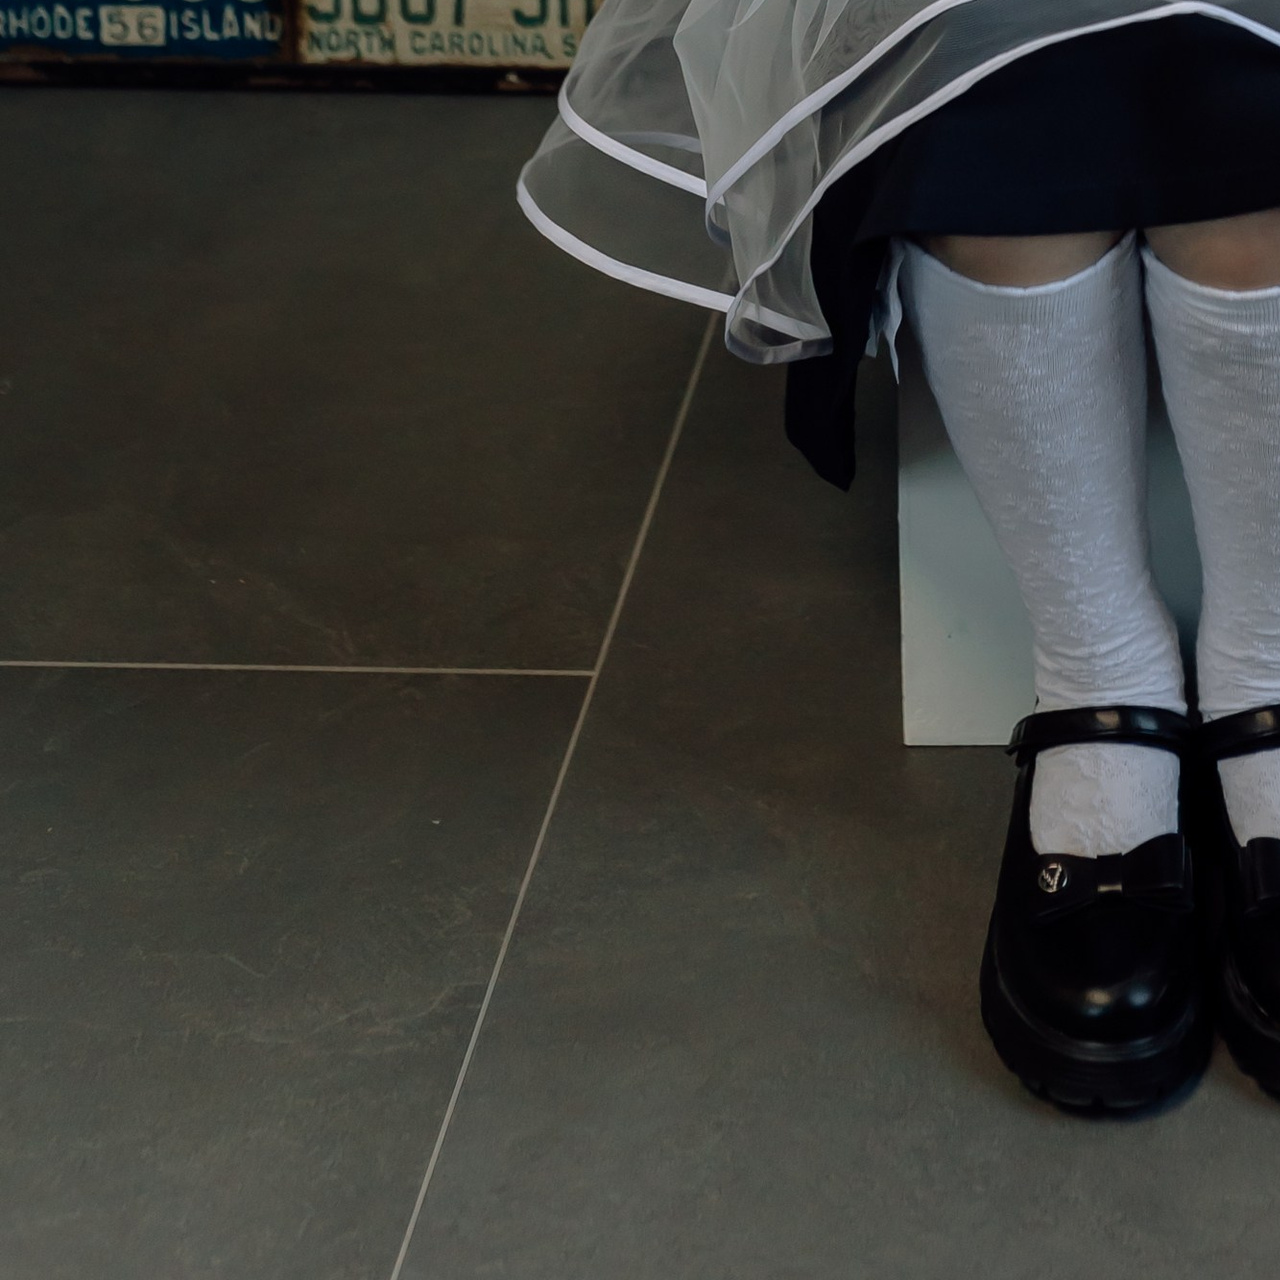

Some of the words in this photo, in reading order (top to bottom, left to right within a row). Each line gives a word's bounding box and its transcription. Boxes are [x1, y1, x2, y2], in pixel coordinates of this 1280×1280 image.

[106, 7, 161, 42] 56
[168, 3, 284, 41] ISLAND
[409, 29, 555, 60] CAROLINA
